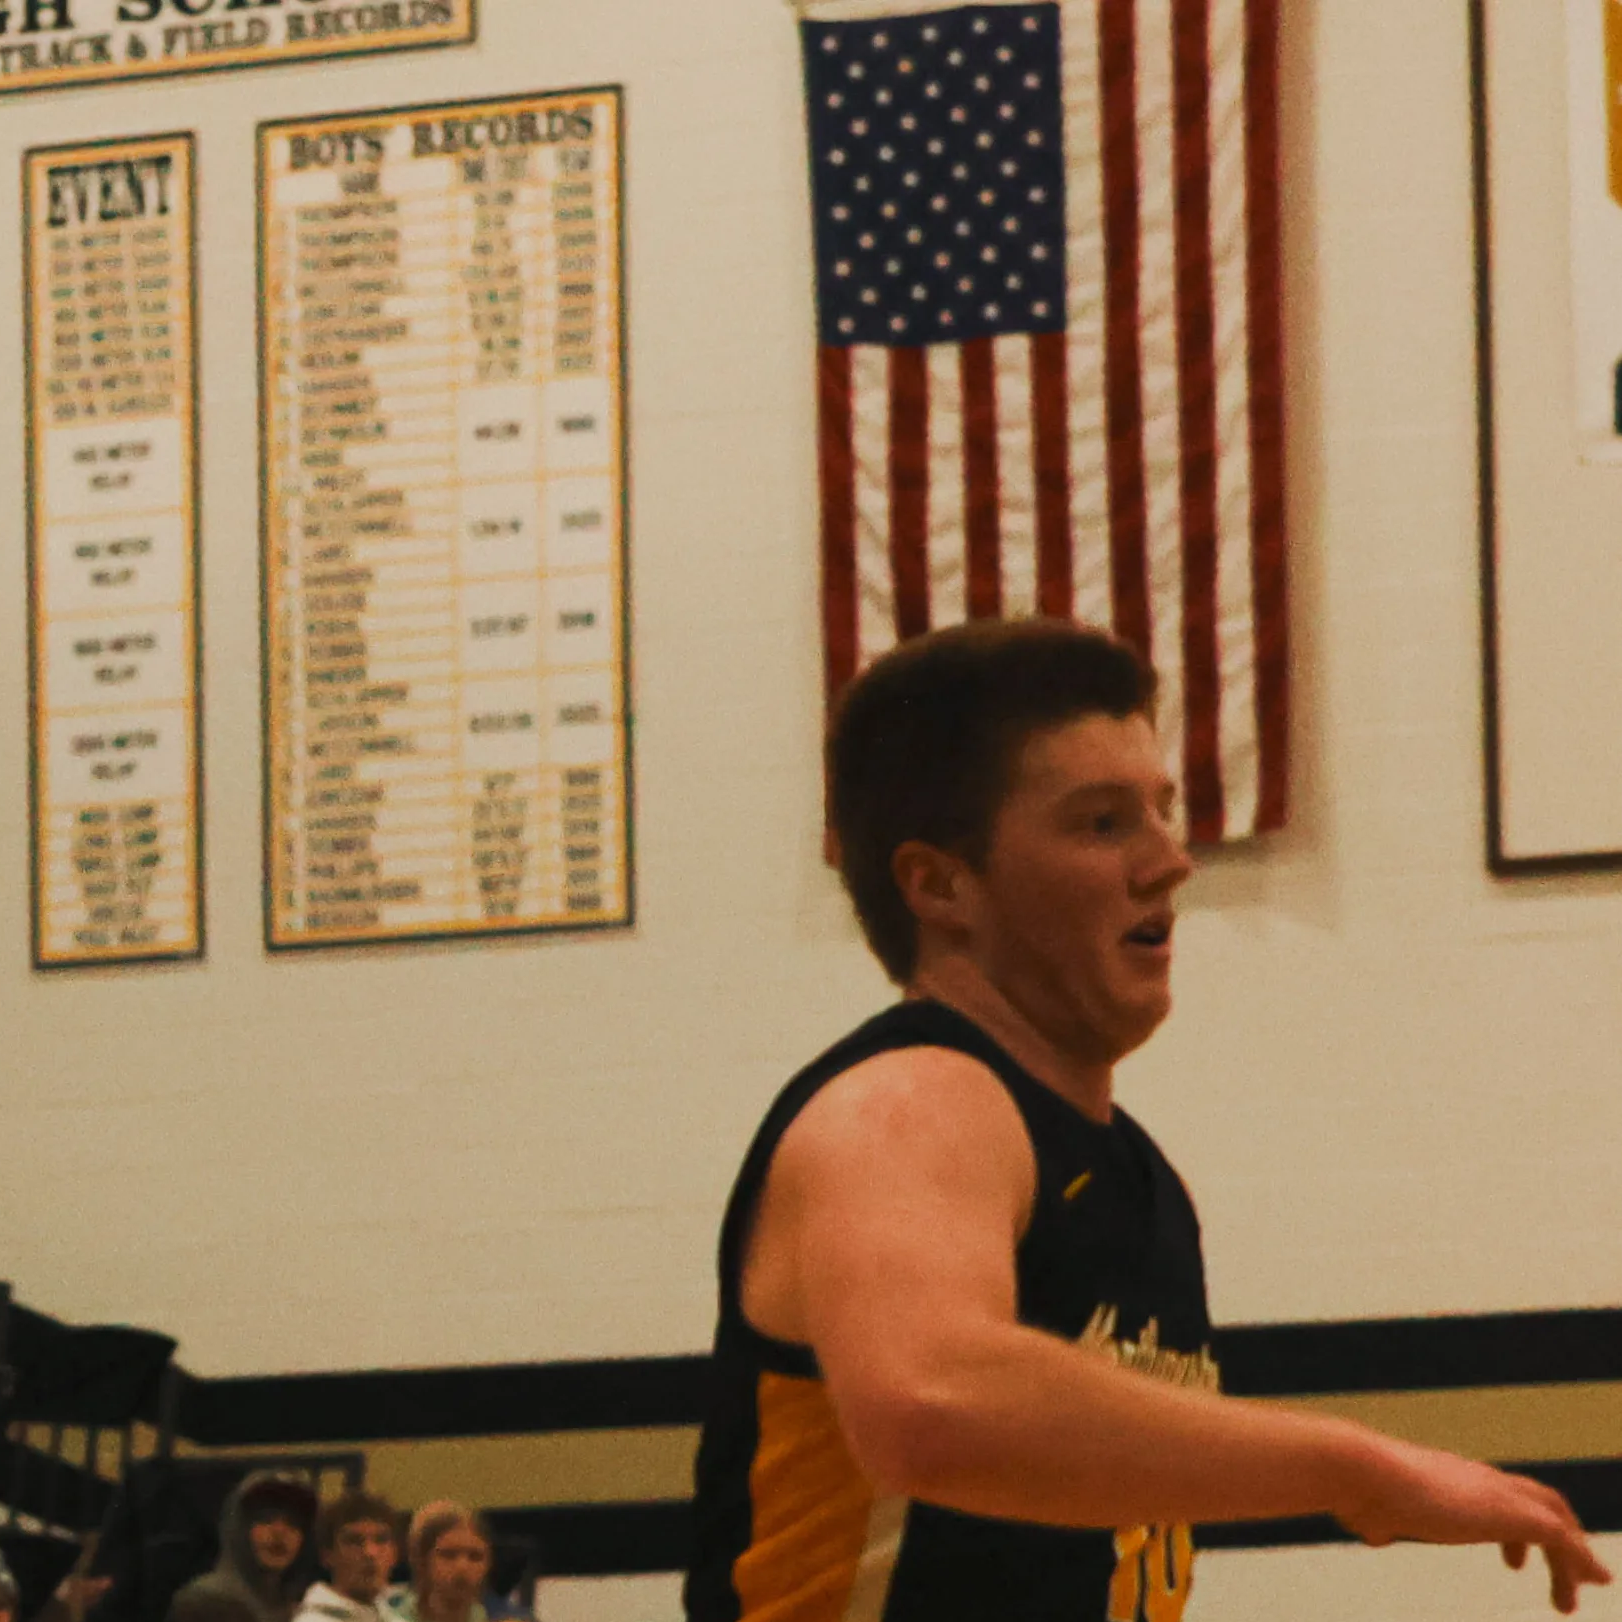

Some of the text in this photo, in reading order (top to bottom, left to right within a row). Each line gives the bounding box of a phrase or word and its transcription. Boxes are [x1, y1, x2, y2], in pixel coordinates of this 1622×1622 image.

[127, 31, 148, 60] &
[162, 16, 271, 56] FIELD
[285, 1, 453, 42] RECORDS
[412, 103, 595, 158] RECORDS
[47, 156, 172, 228] EVENT
